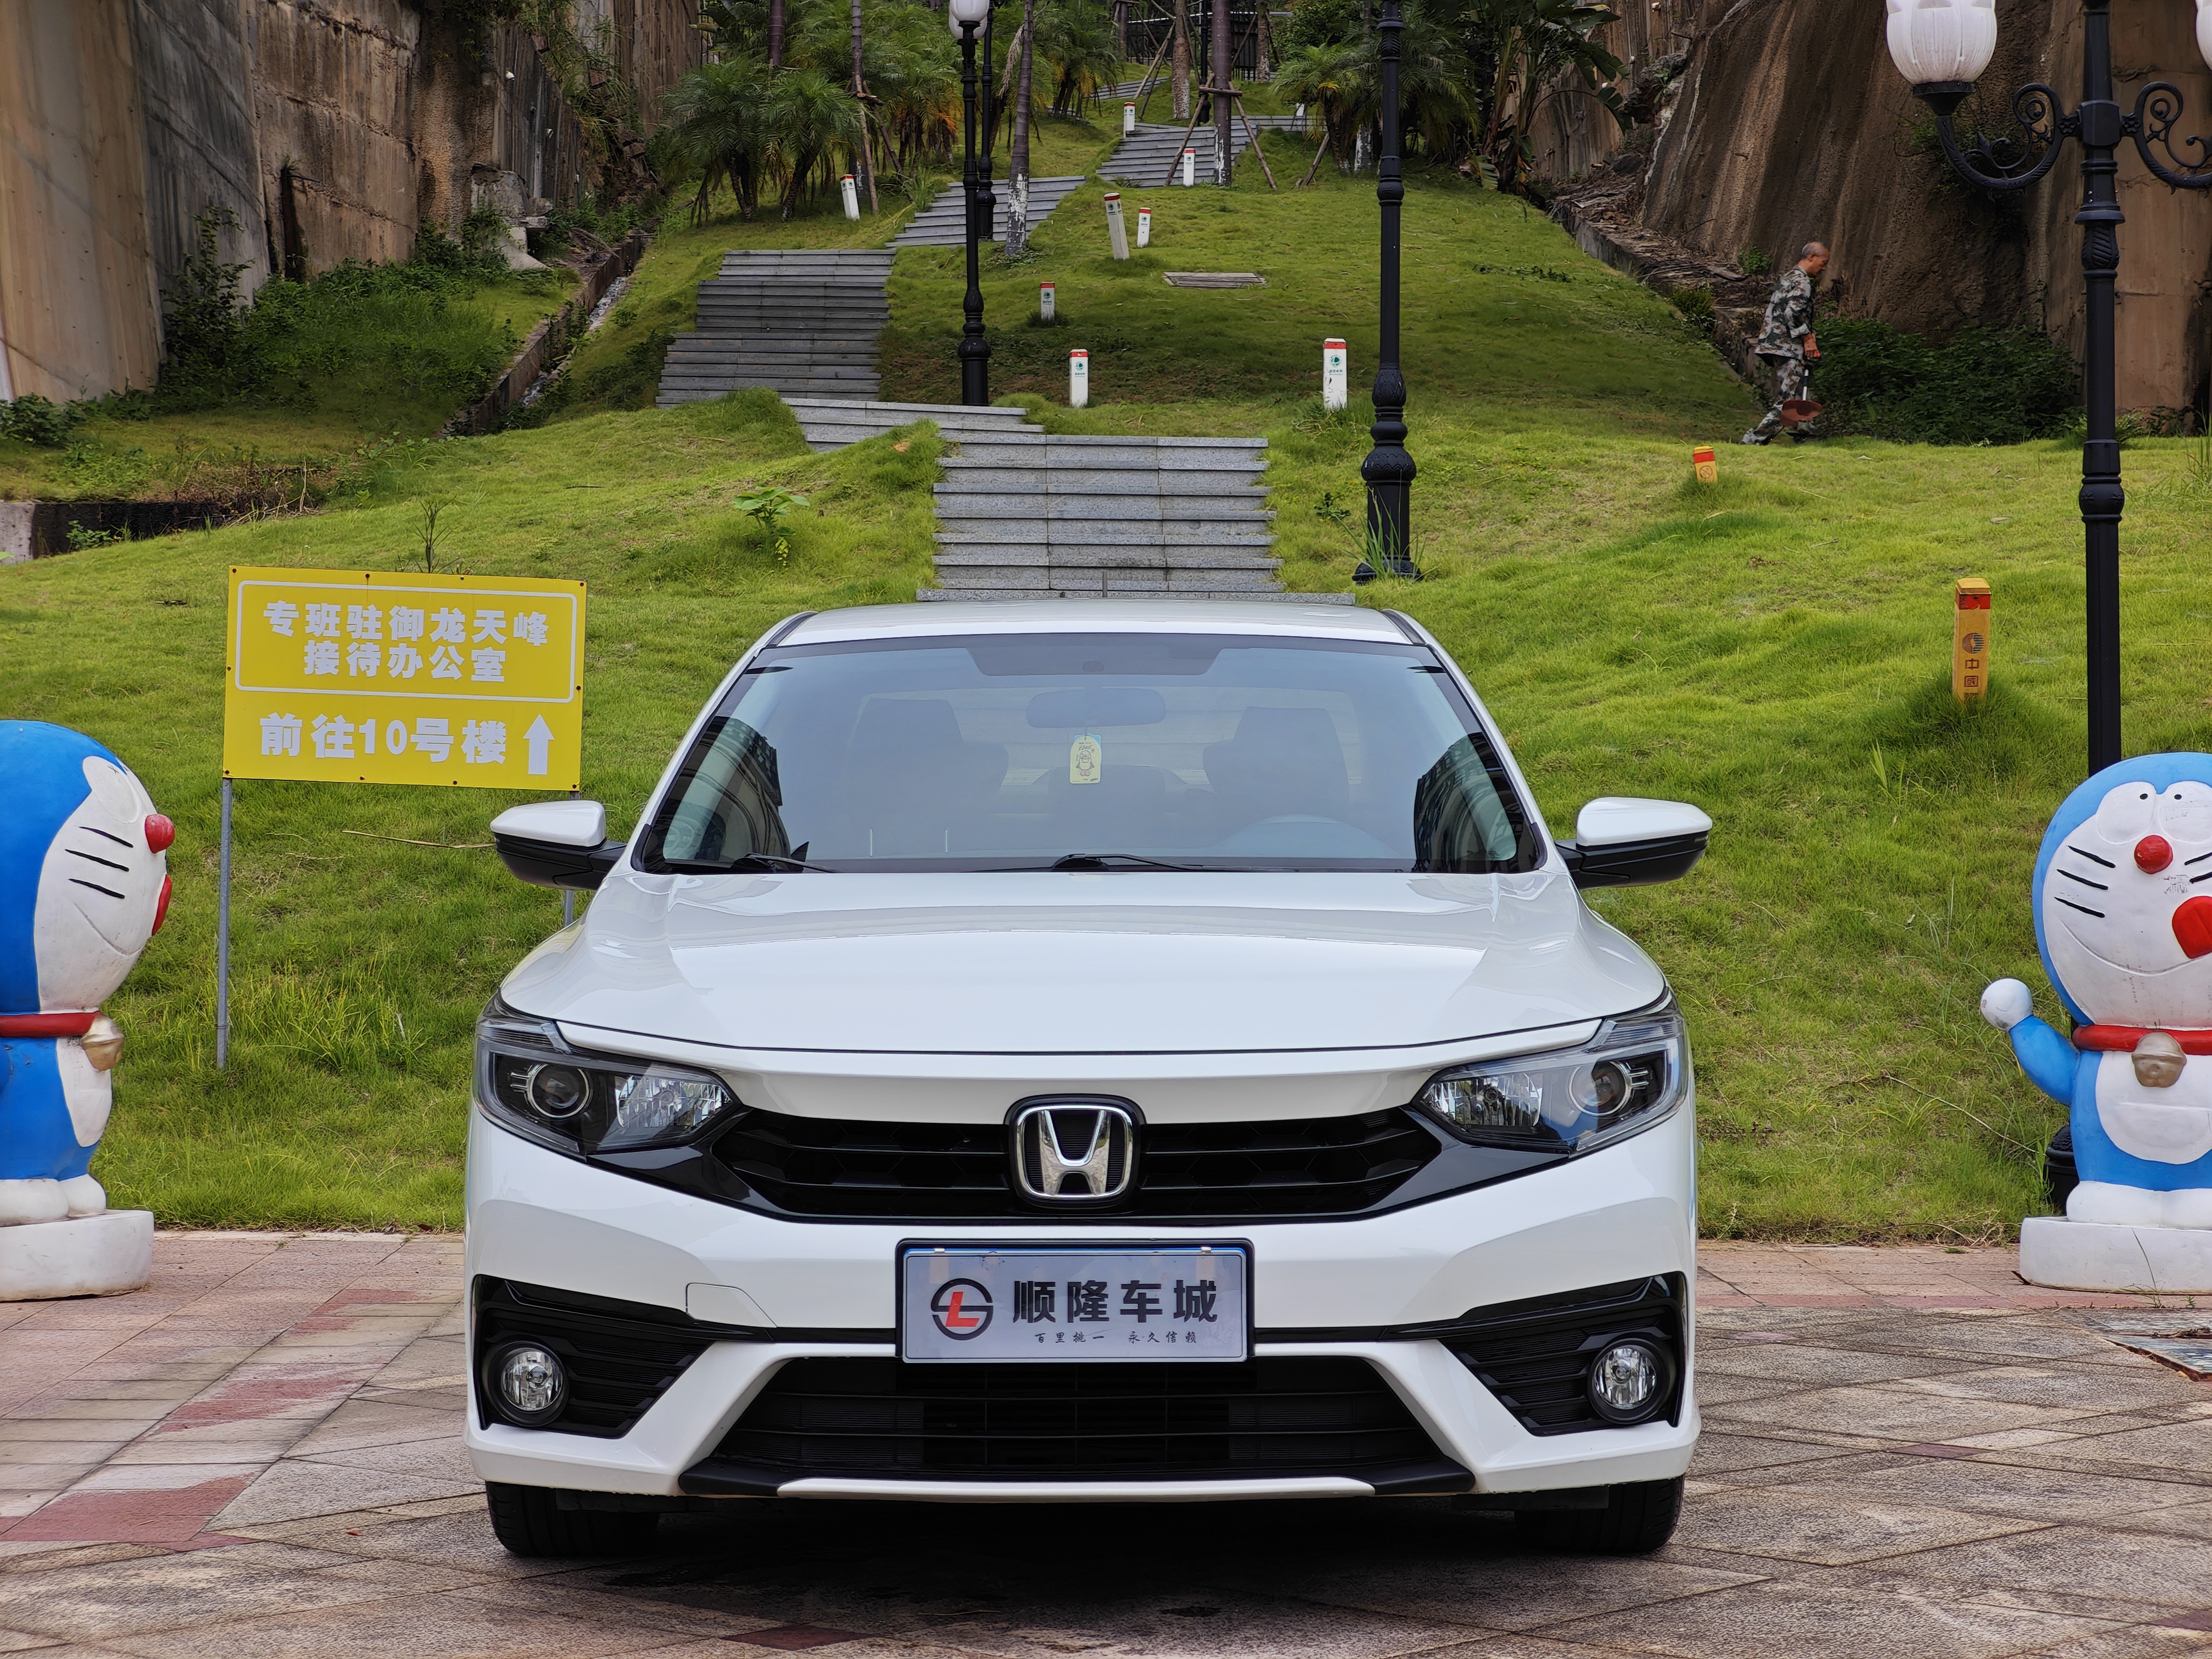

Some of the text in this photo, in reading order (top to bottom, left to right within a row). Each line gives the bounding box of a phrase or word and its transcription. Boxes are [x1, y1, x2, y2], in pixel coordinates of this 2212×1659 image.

[264, 600, 549, 646] 专班驻御龙天峰
[304, 640, 506, 683] 接待办公室
[260, 712, 507, 765] 前往10号楼
[1013, 1279, 1217, 1324] 顺隆车城
[1035, 1331, 1197, 1344] 百里挑一 永久信赖
